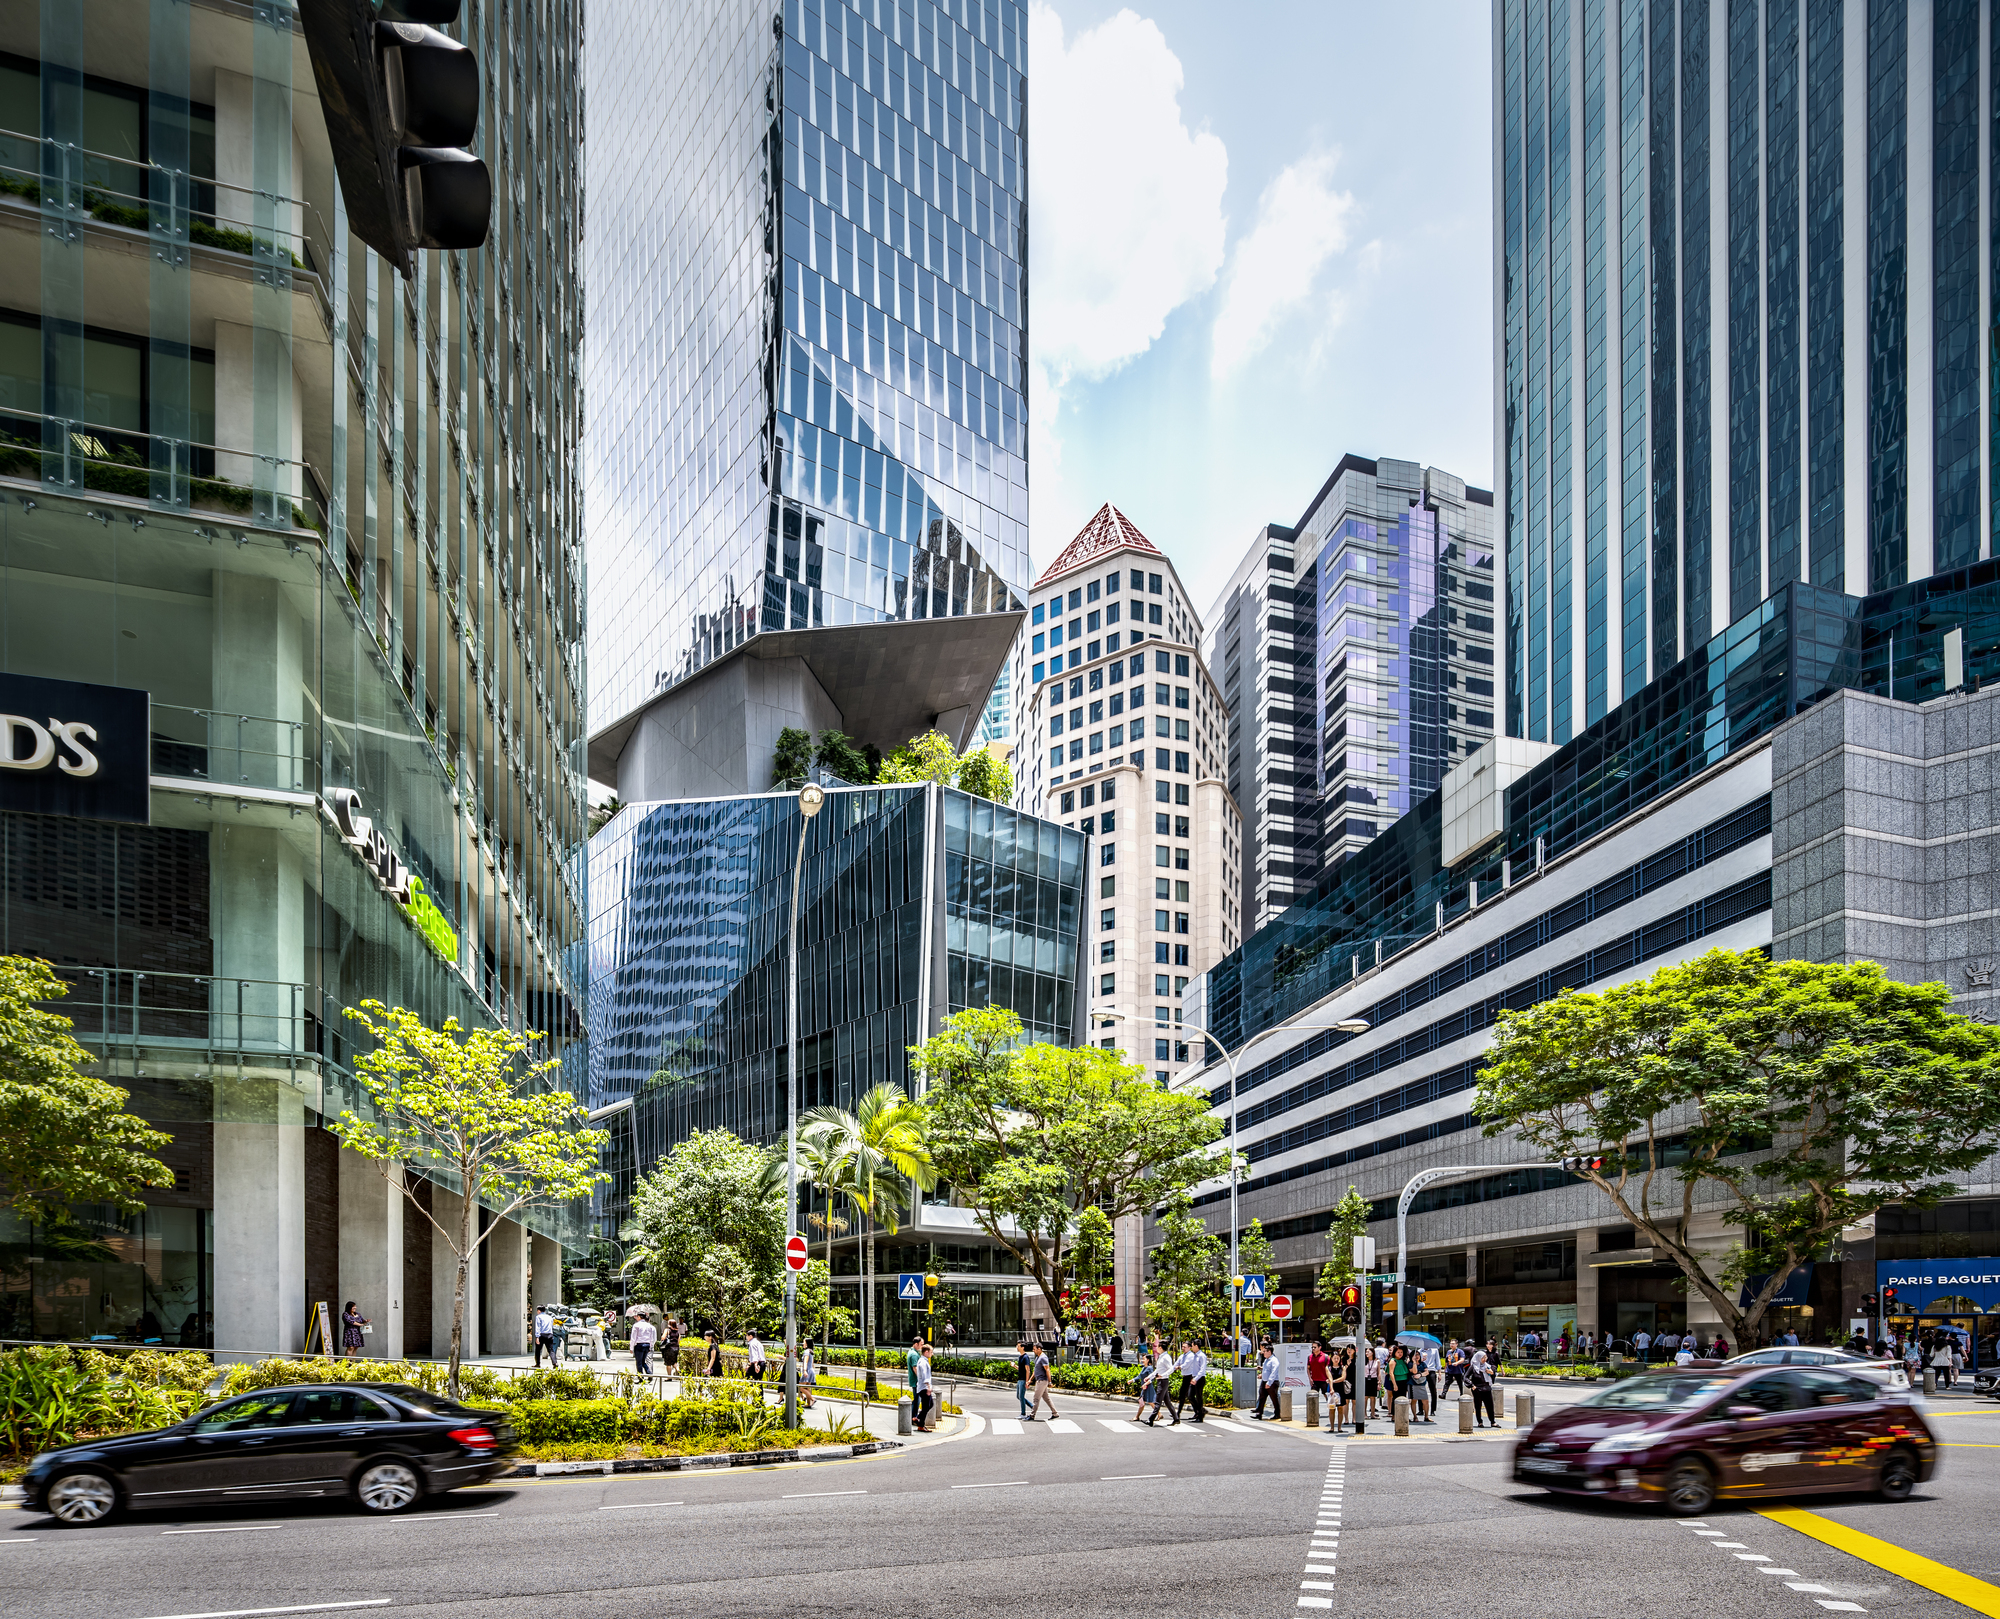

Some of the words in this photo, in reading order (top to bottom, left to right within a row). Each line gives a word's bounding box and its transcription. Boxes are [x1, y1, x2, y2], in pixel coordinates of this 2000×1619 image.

[86, 1219, 130, 1234] TRADERS
[1387, 1274, 1395, 1282] Rd
[1888, 1276, 1933, 1286] PARIS
[1938, 1275, 2000, 1285] BAGUET
